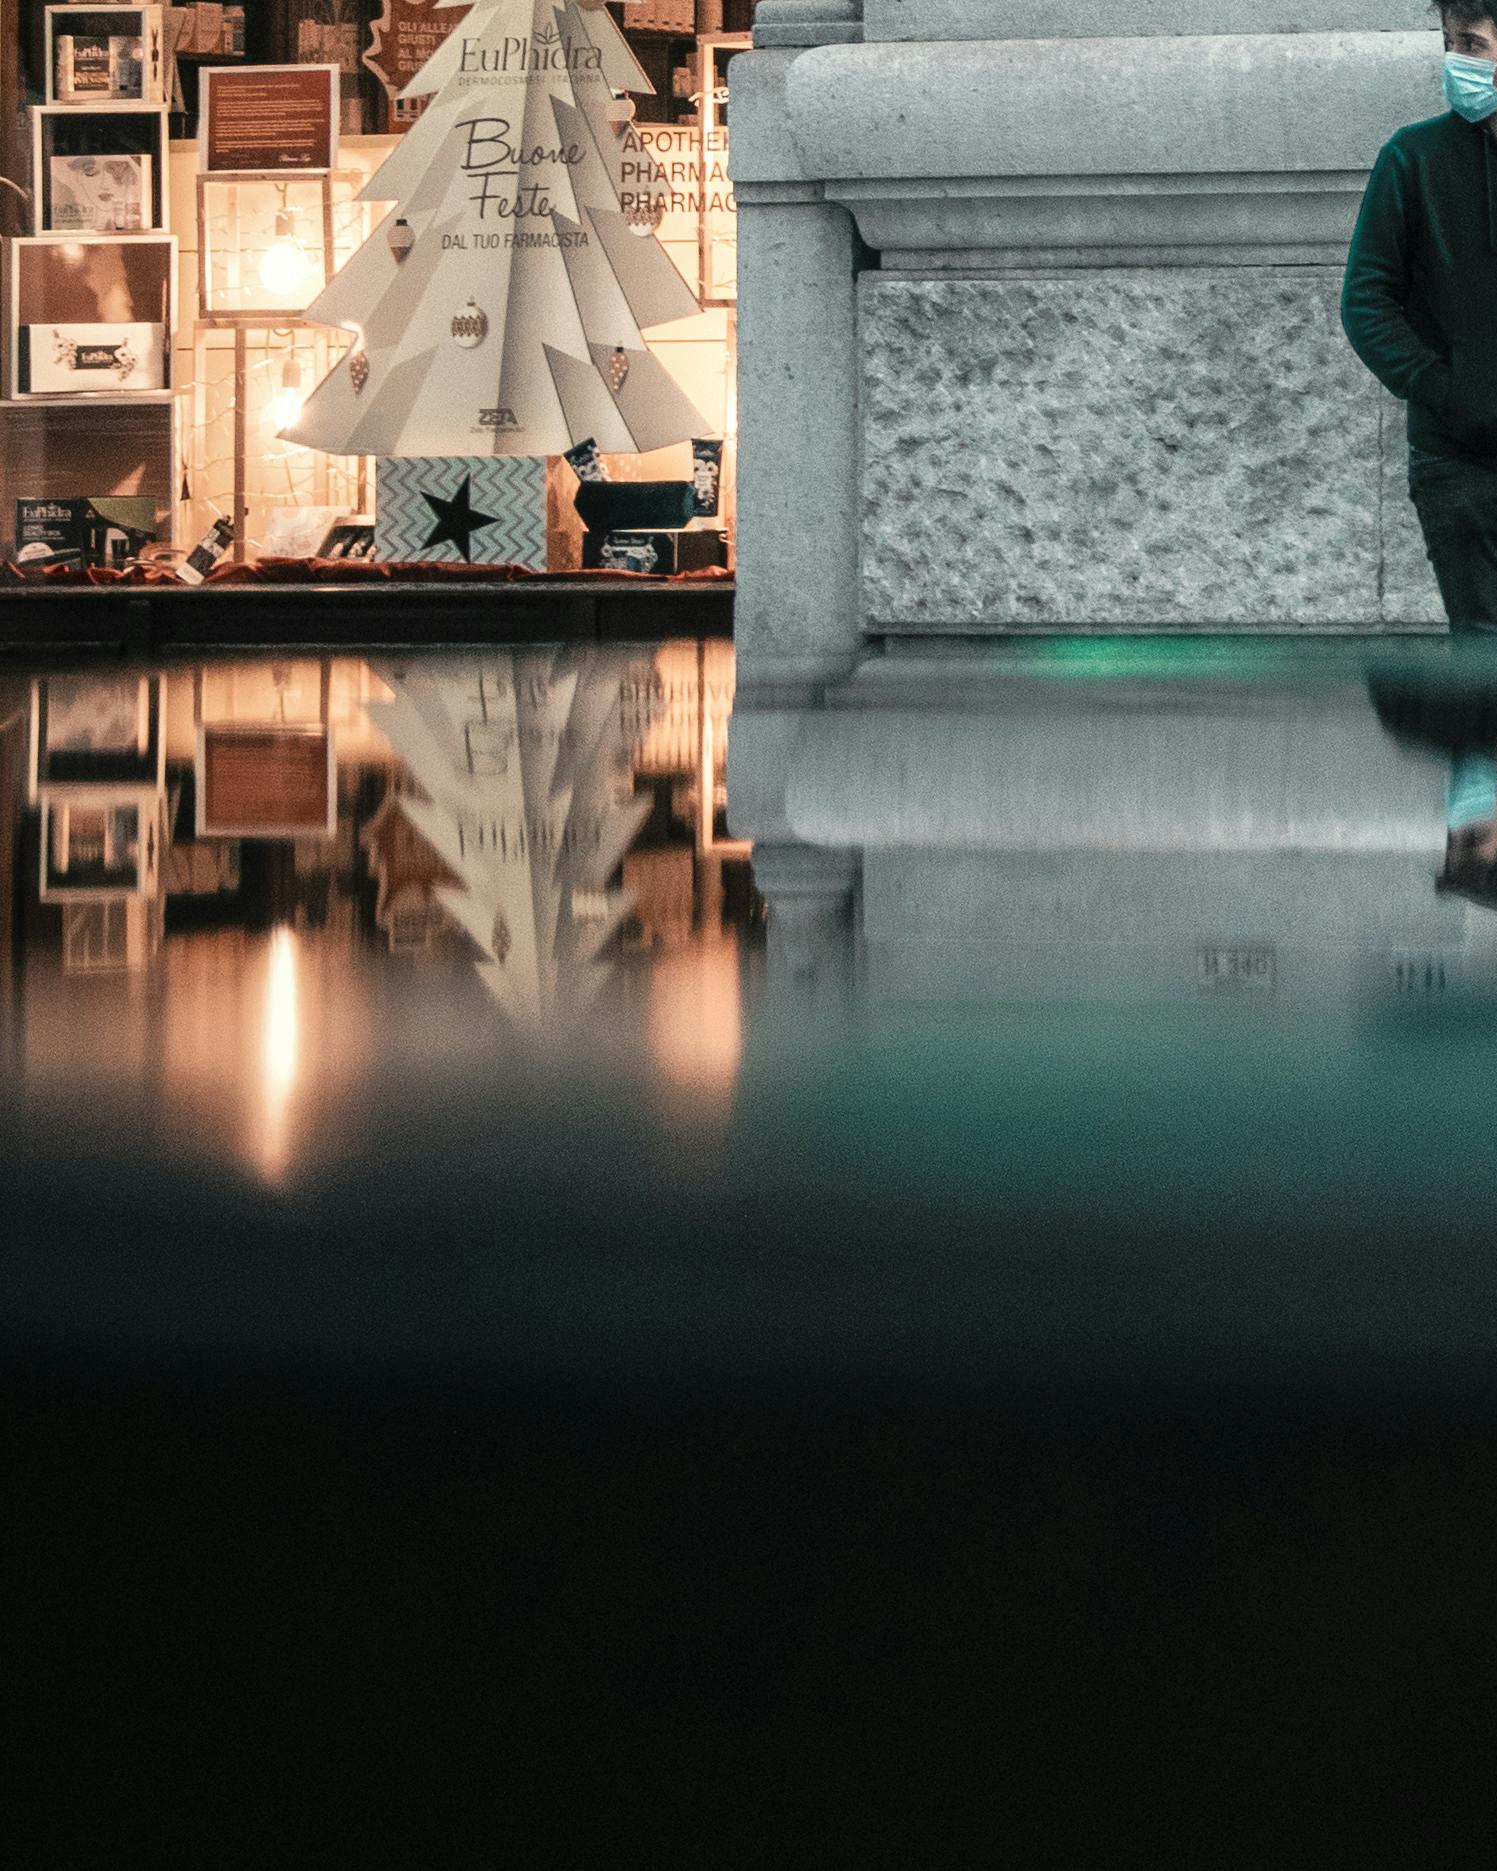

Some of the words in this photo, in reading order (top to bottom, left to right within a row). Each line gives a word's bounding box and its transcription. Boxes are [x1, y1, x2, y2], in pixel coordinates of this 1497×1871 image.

[419, 22, 453, 33] ALLE
[459, 36, 603, 73] EuPhidra
[454, 117, 587, 172] Buone
[620, 162, 730, 184] PHARMA
[467, 170, 558, 221] Feste
[441, 233, 468, 250] DAL
[473, 233, 500, 249] TUO
[503, 231, 590, 249] FARMACISTA
